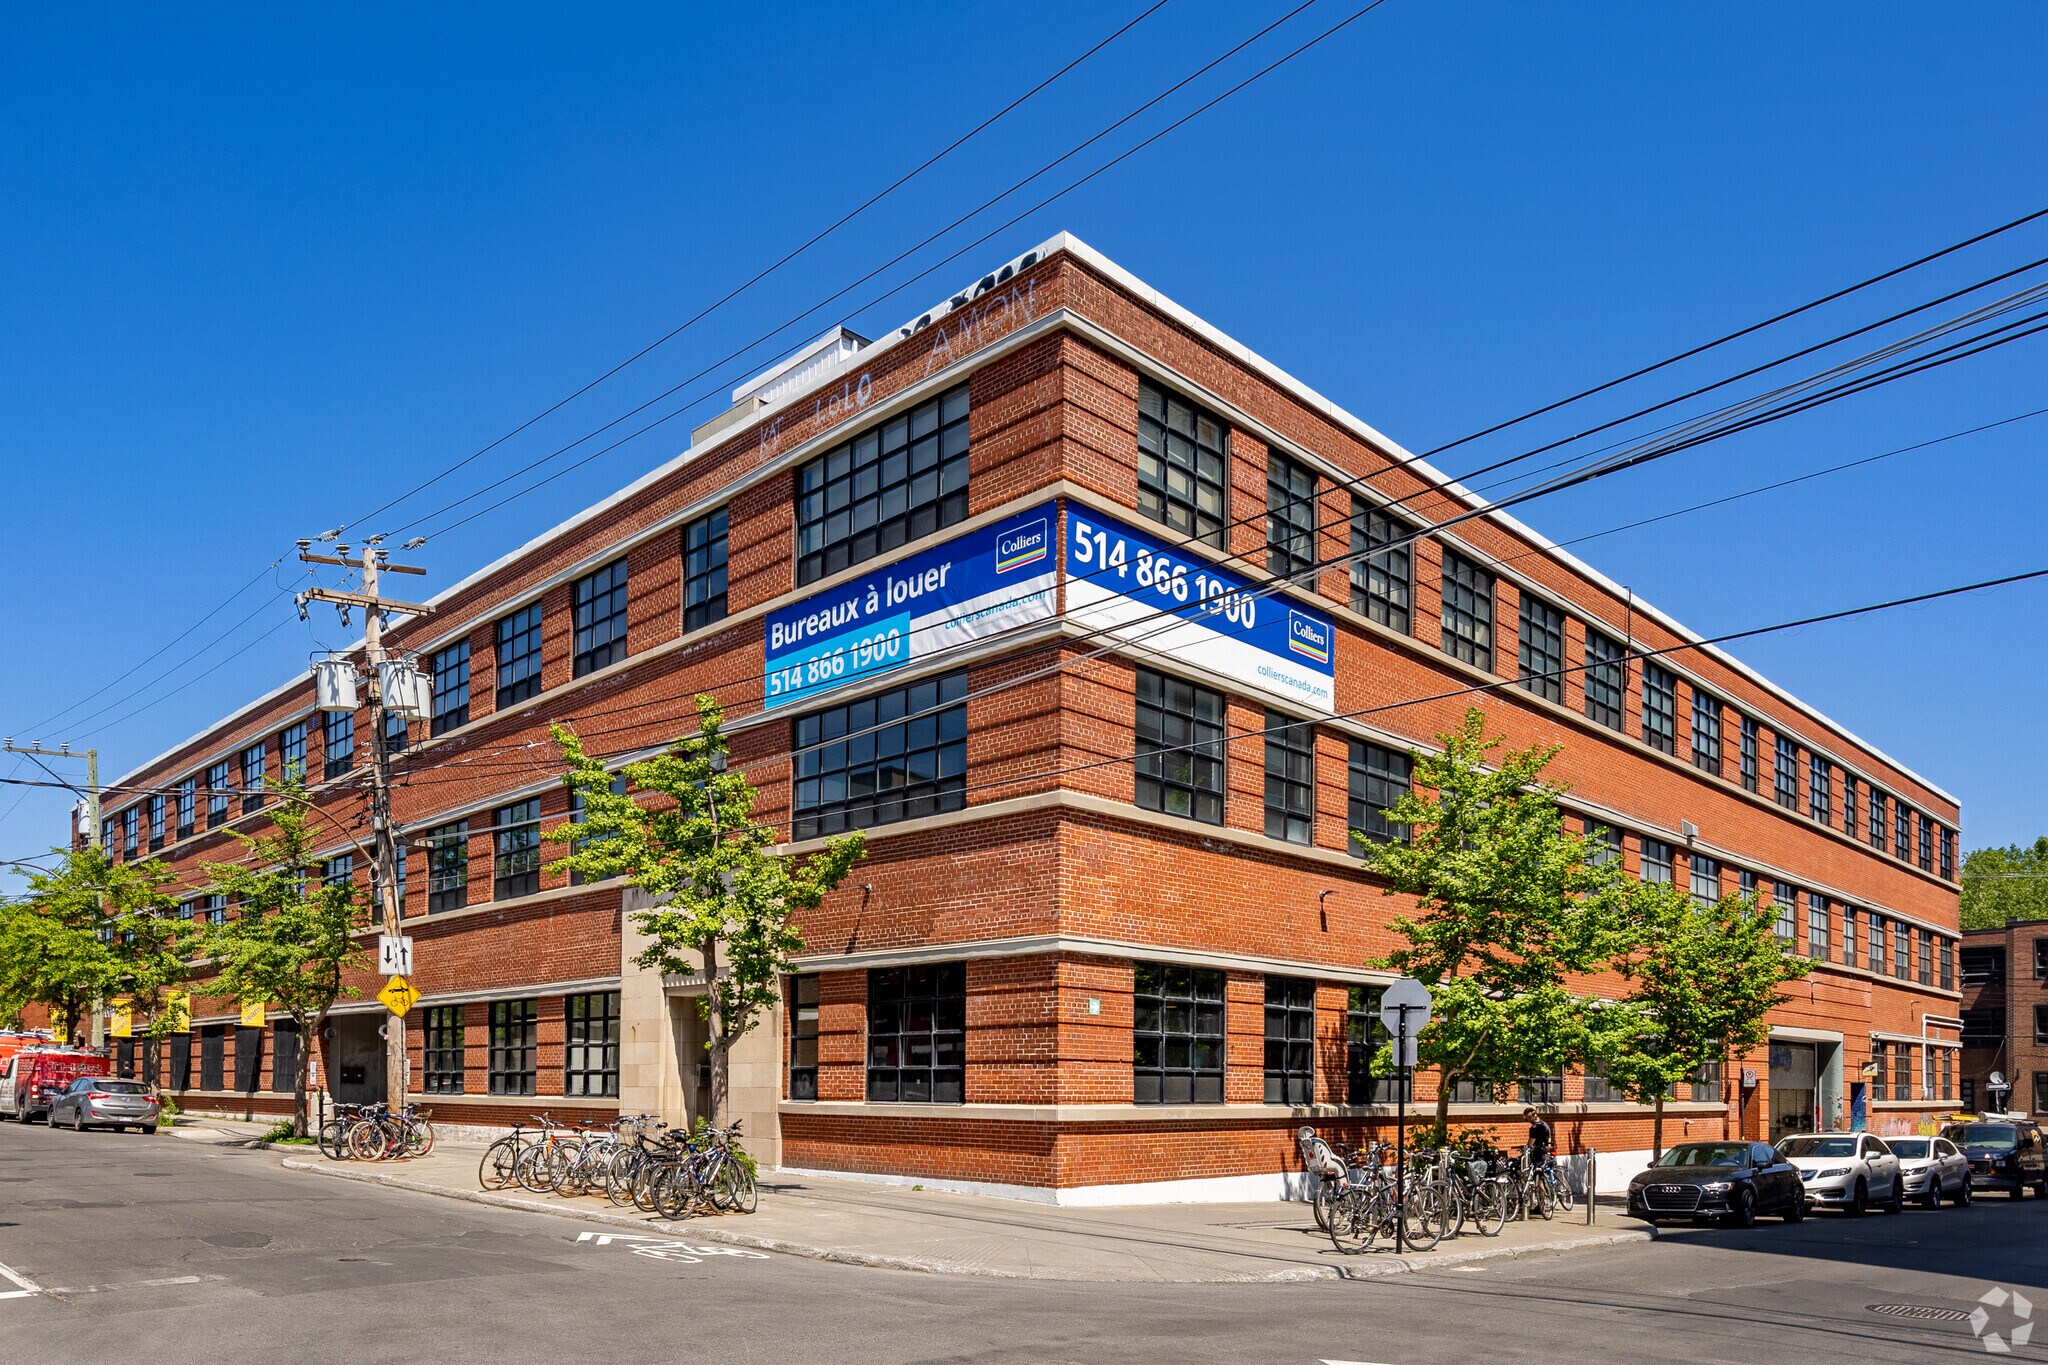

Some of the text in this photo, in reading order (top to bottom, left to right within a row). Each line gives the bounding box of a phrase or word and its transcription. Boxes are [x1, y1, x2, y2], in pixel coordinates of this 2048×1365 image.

[1001, 530, 1041, 555] Colliers
[1074, 521, 1256, 629] 514 866 1900
[771, 562, 952, 650] Bureaux à louer
[1293, 620, 1324, 645] Colliers
[771, 628, 900, 696] 514 866 1900
[1257, 664, 1328, 698] collierscanada.com
